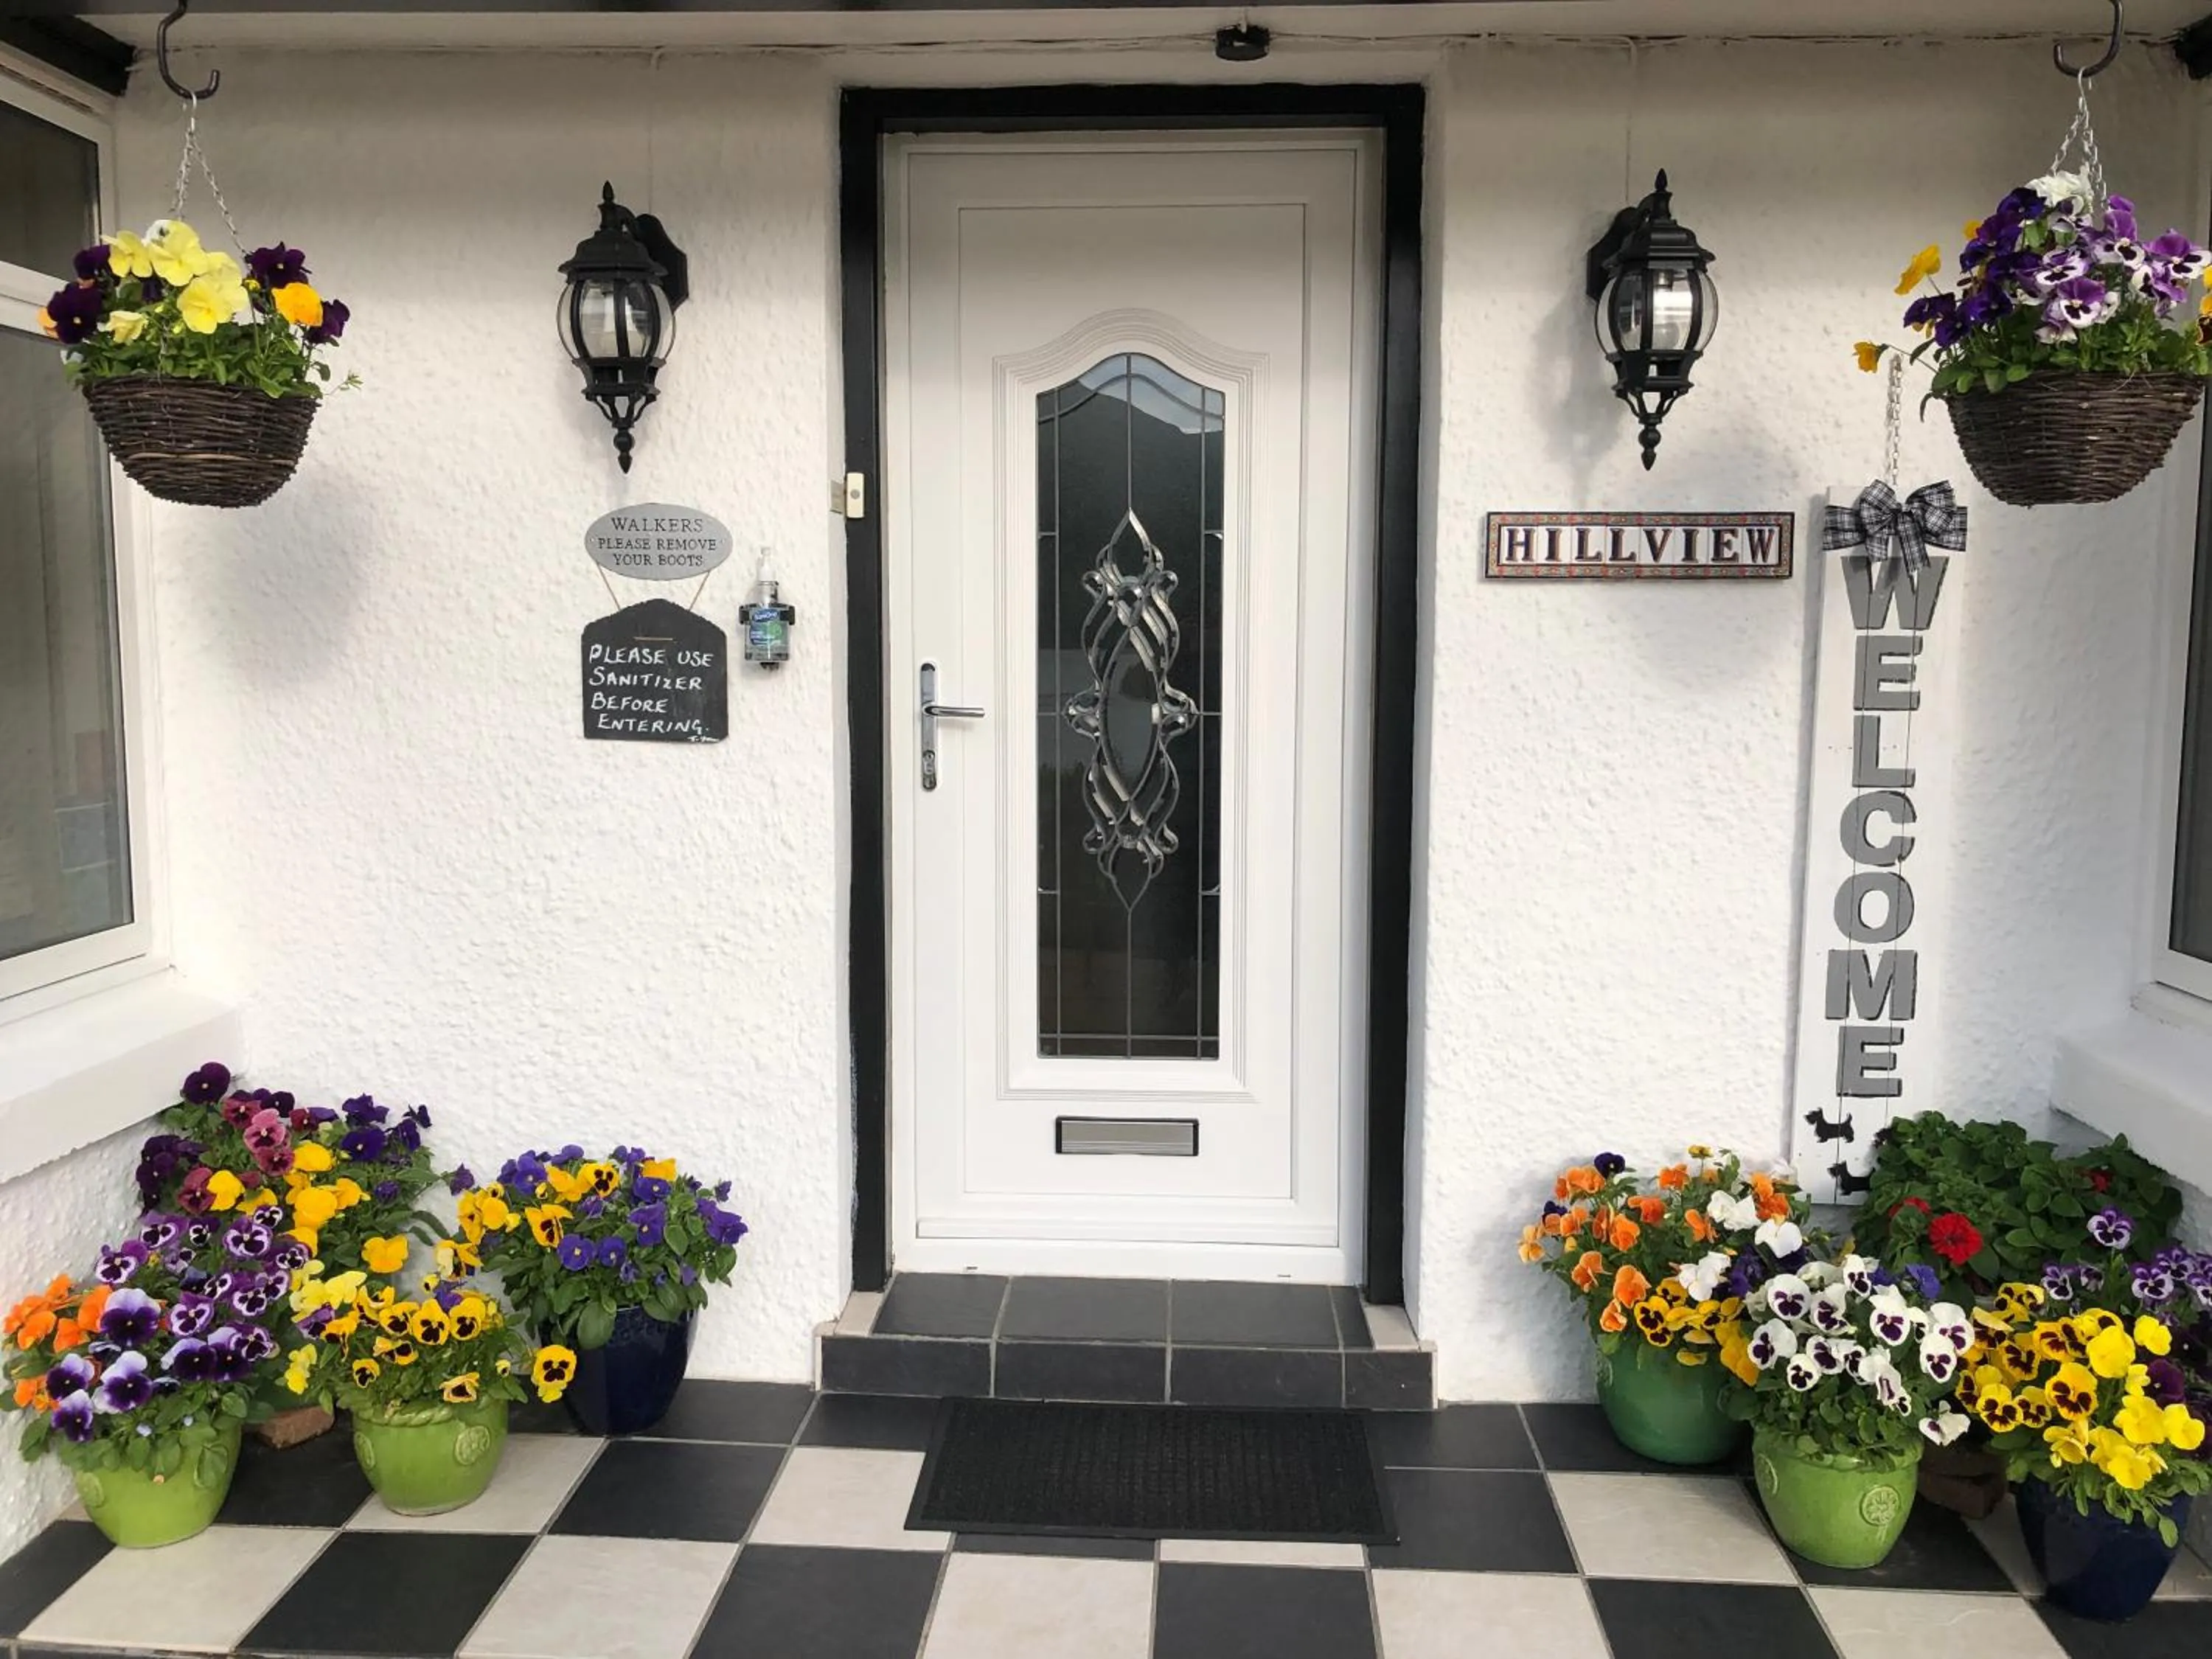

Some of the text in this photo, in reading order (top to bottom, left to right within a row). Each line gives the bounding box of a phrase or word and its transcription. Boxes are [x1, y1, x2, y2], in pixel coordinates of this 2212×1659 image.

[611, 518, 703, 532] WALKERS
[598, 538, 716, 550] PLEASE REMOVE
[1505, 527, 1775, 563] HILLVIEW
[613, 554, 703, 566] YOUR BOOTS
[589, 644, 714, 667] PLEASE USE
[588, 667, 702, 690] SANITIZER
[591, 692, 669, 713] BEFORE
[597, 713, 709, 734] ENTERING.
[1825, 556, 1950, 1097] WELCOME
